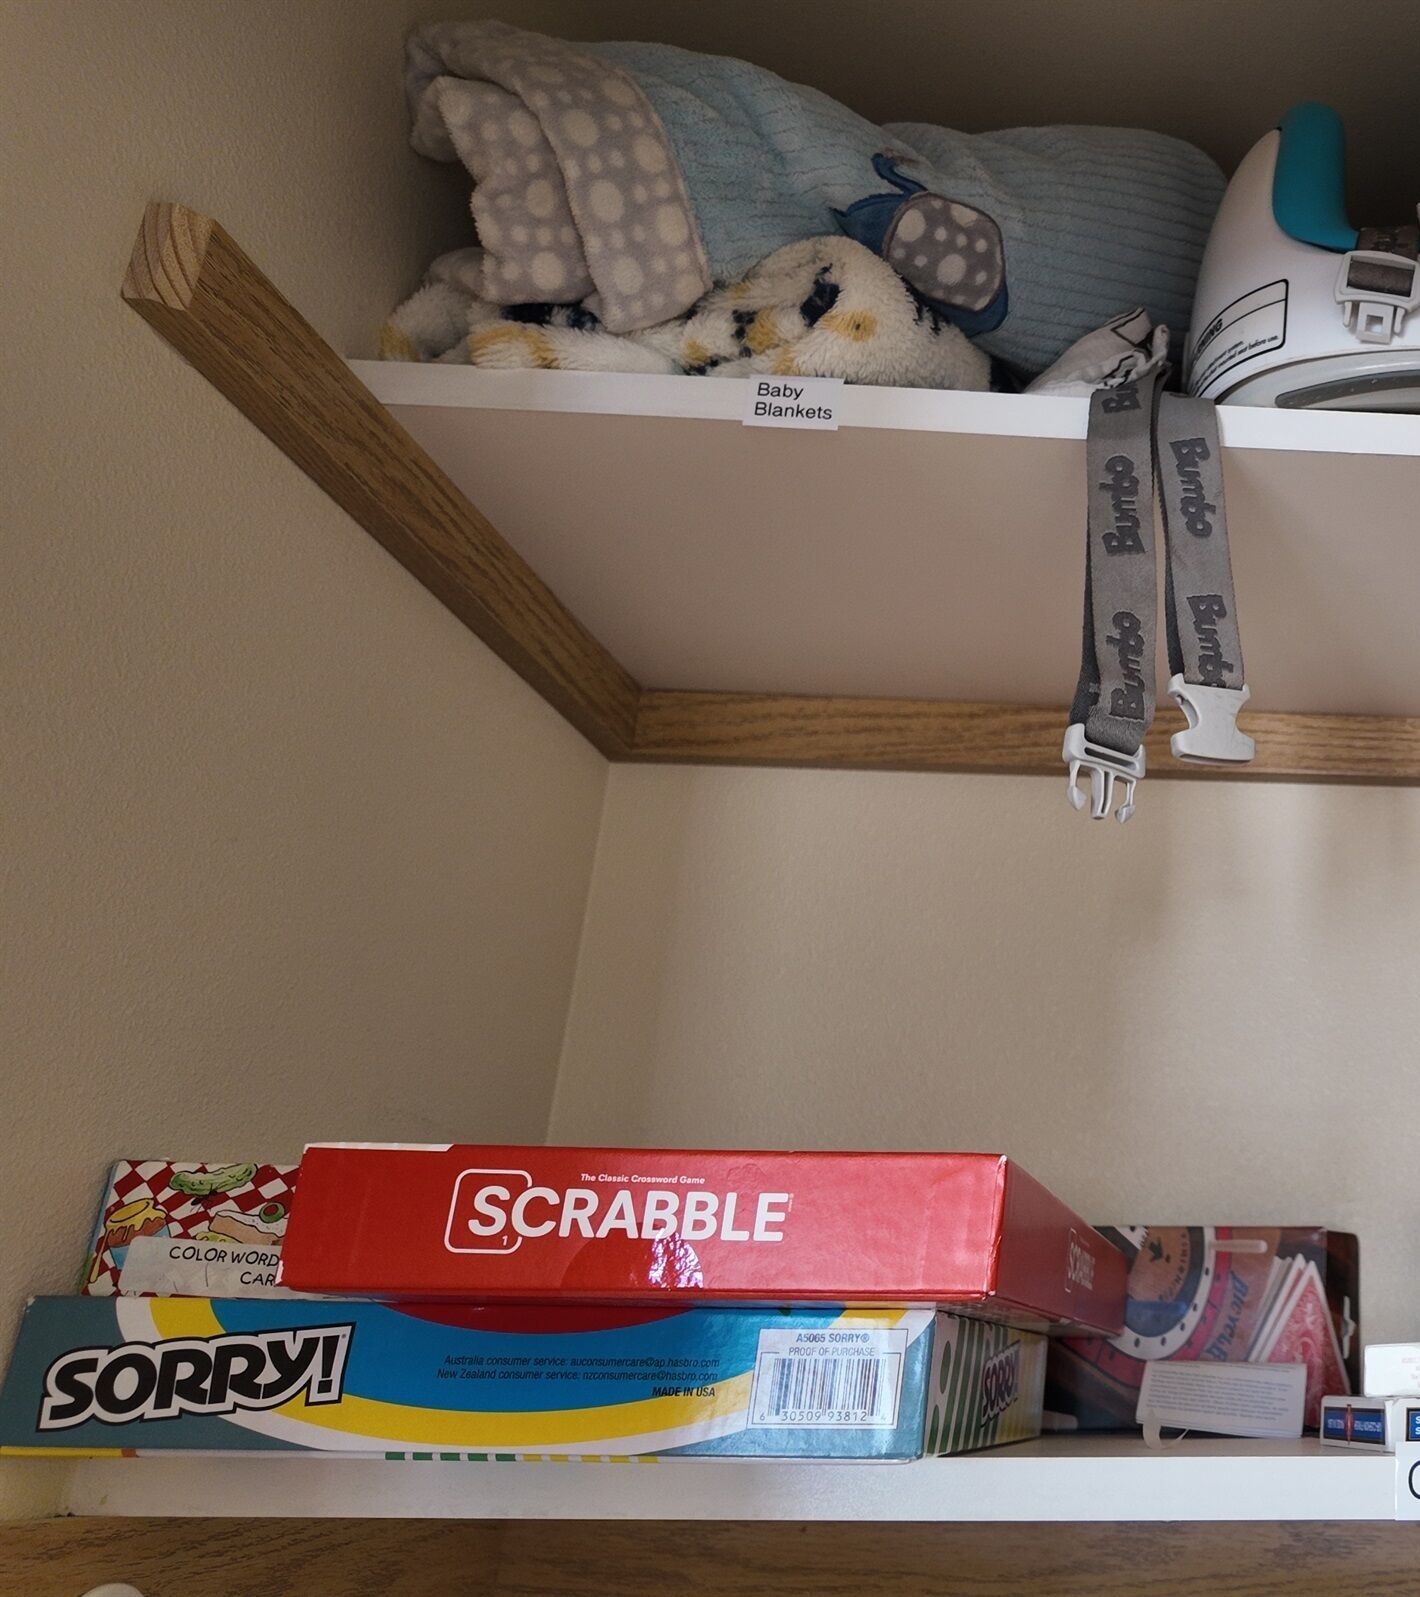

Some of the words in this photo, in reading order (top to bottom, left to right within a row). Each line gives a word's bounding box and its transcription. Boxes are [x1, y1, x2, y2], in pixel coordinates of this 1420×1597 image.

[757, 382, 804, 400] Baby
[754, 401, 832, 420] Blankets
[1169, 437, 1216, 537] Bumbo
[1099, 454, 1145, 554] Bumbo
[1186, 594, 1233, 688] Bumb
[1106, 610, 1146, 720] Bumbo
[581, 1173, 596, 1182] The
[598, 1173, 629, 1183] Classic
[631, 1174, 678, 1184] Crossword
[680, 1175, 705, 1185] Game
[468, 1185, 789, 1242] SCRABBLE
[502, 1235, 508, 1246] 1
[169, 1246, 226, 1263] COLOR
[231, 1250, 280, 1268] WORD
[796, 1333, 825, 1343] A5065
[444, 1355, 484, 1366] Australia
[486, 1357, 531, 1366] consumer
[789, 1347, 817, 1356] PROOF
[818, 1347, 830, 1356] OF
[831, 1347, 875, 1357] PURCHASE
[42, 1329, 346, 1426] SORRY!
[437, 1368, 457, 1379] New
[460, 1369, 497, 1380] Zealand
[499, 1370, 543, 1380] consumer
[652, 1386, 682, 1397] MADE
[683, 1386, 694, 1397] IN
[696, 1386, 716, 1397] USA
[759, 1412, 766, 1421] 6
[781, 1410, 822, 1421] 30509
[827, 1410, 868, 1422] 93812
